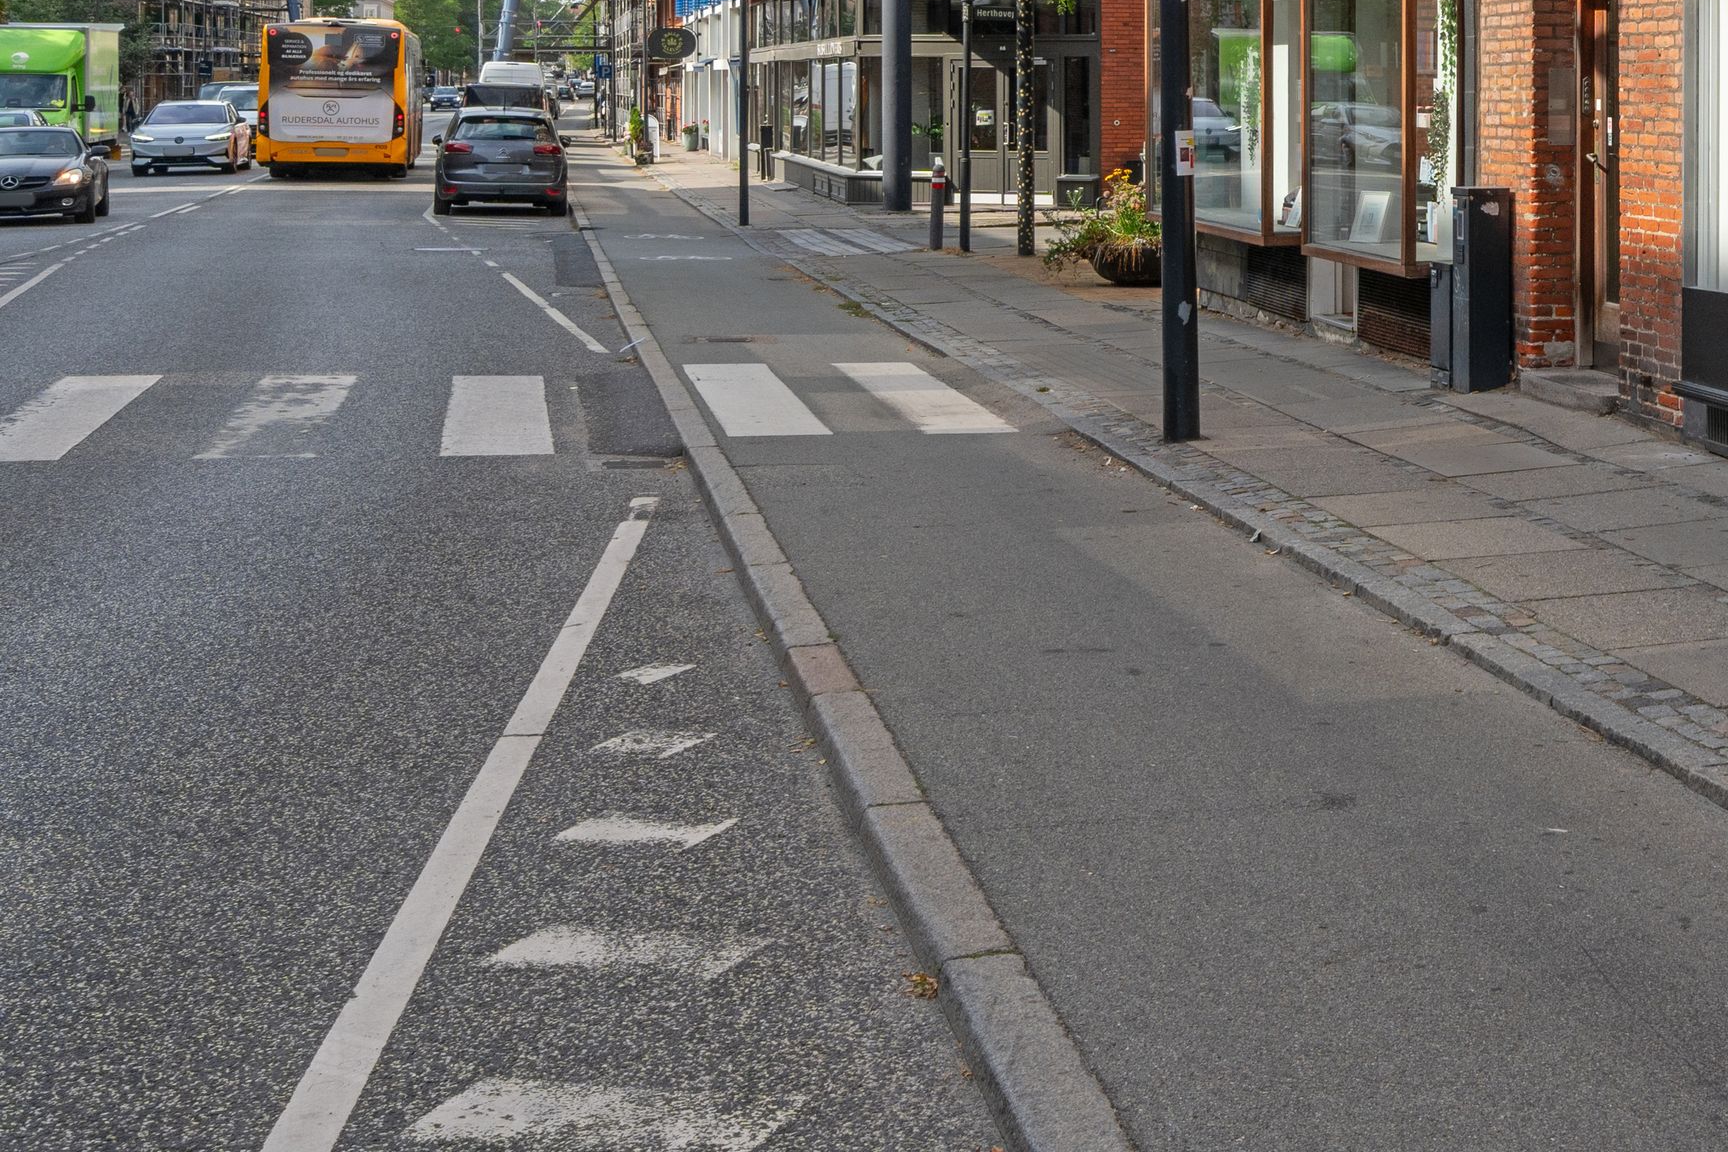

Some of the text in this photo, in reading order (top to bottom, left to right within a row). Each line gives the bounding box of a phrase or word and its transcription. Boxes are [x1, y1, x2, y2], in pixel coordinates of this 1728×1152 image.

[601, 66, 611, 78] P
[358, 76, 381, 84] erfaring
[281, 115, 380, 126] RUDERSDAL AUTOHUS
